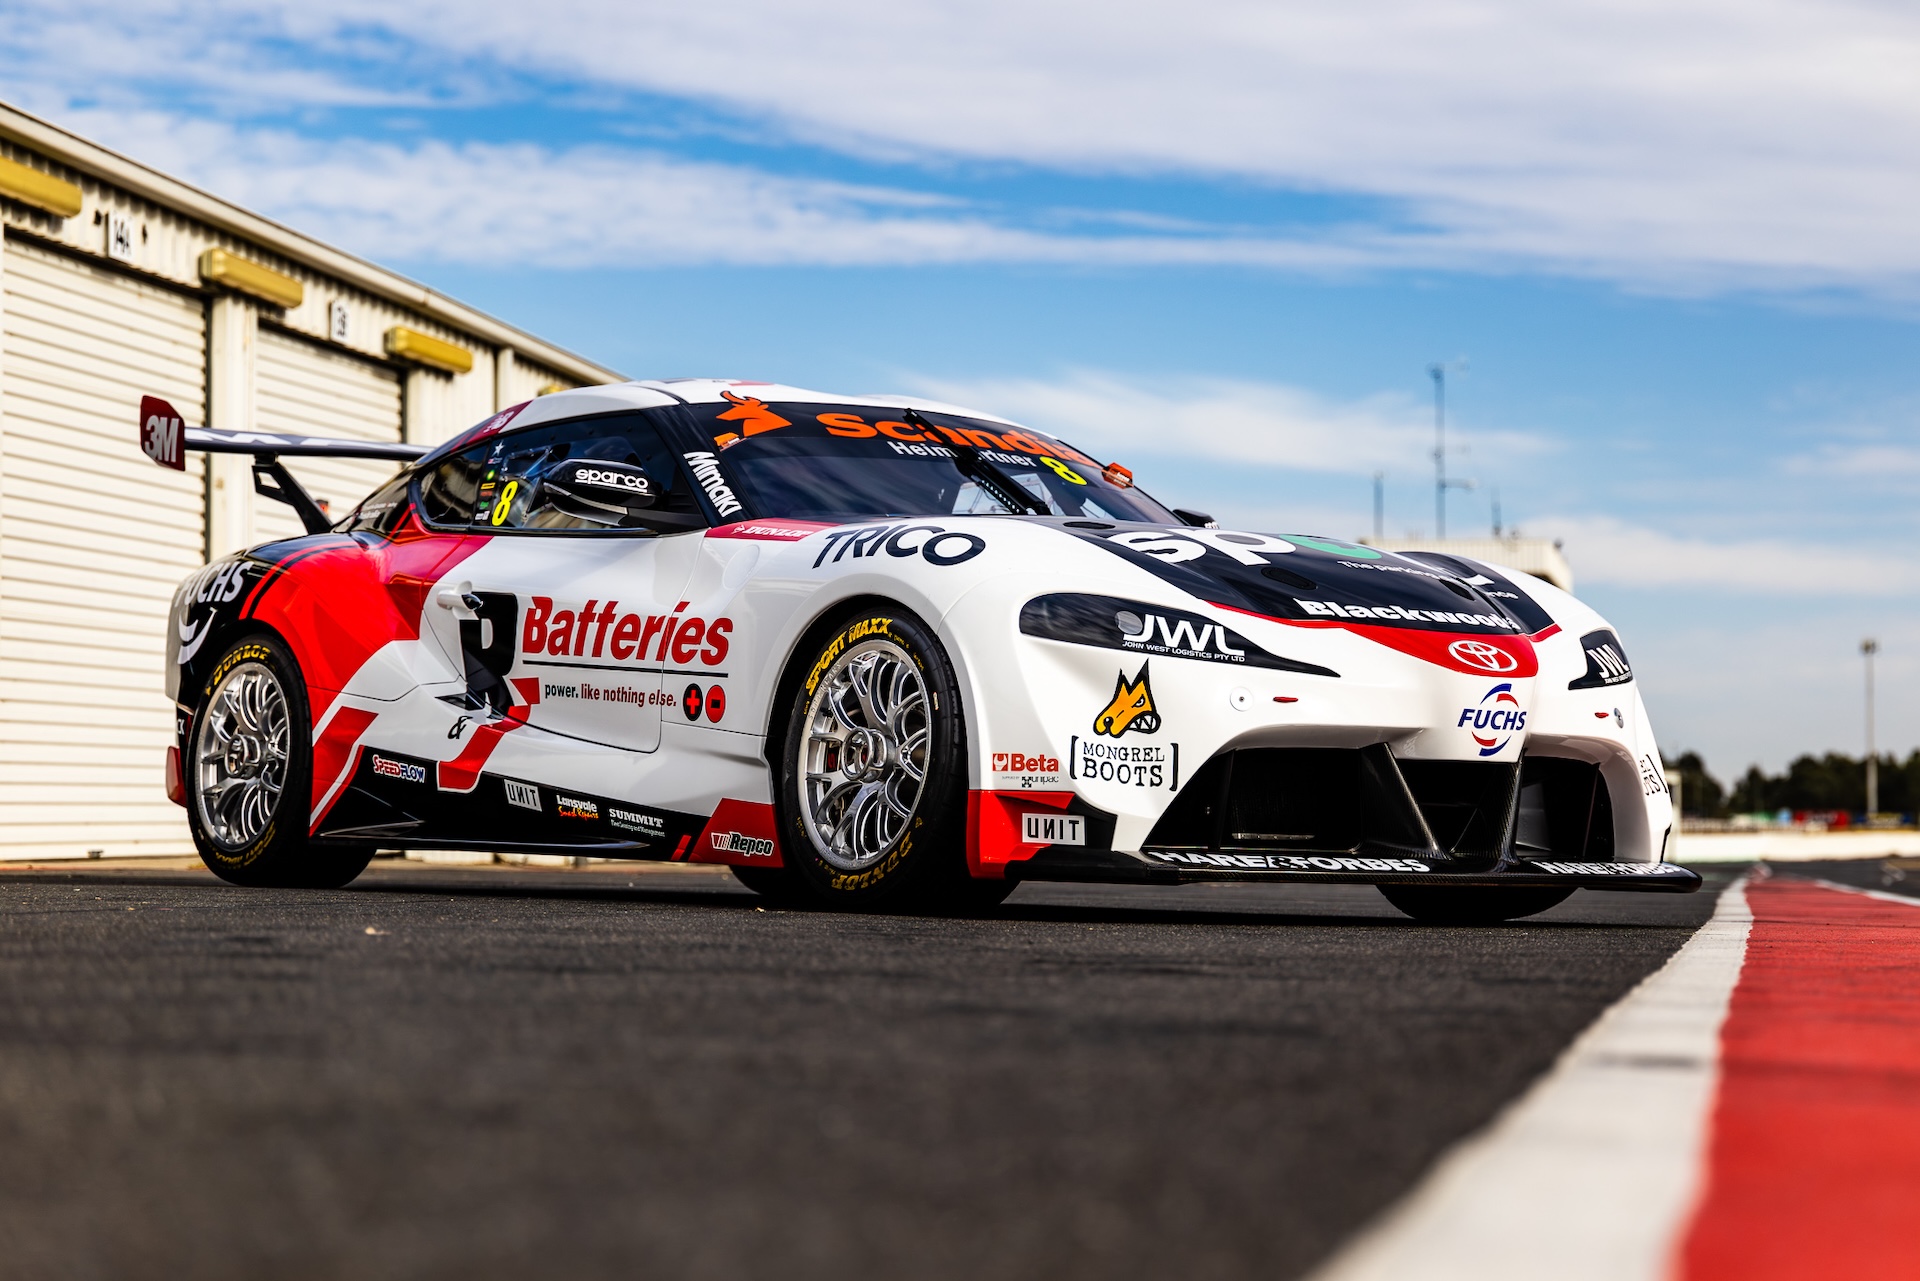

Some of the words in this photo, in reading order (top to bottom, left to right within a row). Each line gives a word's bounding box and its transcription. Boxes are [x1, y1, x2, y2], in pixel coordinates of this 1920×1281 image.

[145, 414, 180, 463] 3M
[575, 468, 648, 489] sparco
[683, 451, 742, 518] Mimaki
[1040, 456, 1087, 485] 8
[491, 480, 518, 527] 8
[743, 525, 815, 539] DUNLOP
[812, 524, 986, 567] TRICO
[174, 561, 255, 607] FUCHS
[1293, 598, 1522, 631] Blackwoods
[522, 596, 734, 666] Batteries
[1123, 614, 1245, 656] JWL
[213, 644, 271, 686] DUNLOP
[806, 631, 847, 696] SPORT
[848, 618, 893, 643] MAXX
[1122, 641, 1144, 650] JOHN
[1145, 643, 1170, 653] WEST
[1171, 648, 1212, 659] LOGISTICS
[1586, 644, 1629, 679] JWL
[544, 683, 579, 699] power.
[581, 683, 600, 700] like
[603, 686, 645, 708] nothing
[648, 689, 677, 707] else.
[1457, 708, 1527, 731] FUCHS
[1010, 753, 1059, 772] Beta
[1083, 741, 1165, 762] MONGREL
[1082, 757, 1163, 787] BOOTS
[609, 808, 663, 828] SUMMIT
[729, 831, 774, 856] Repco
